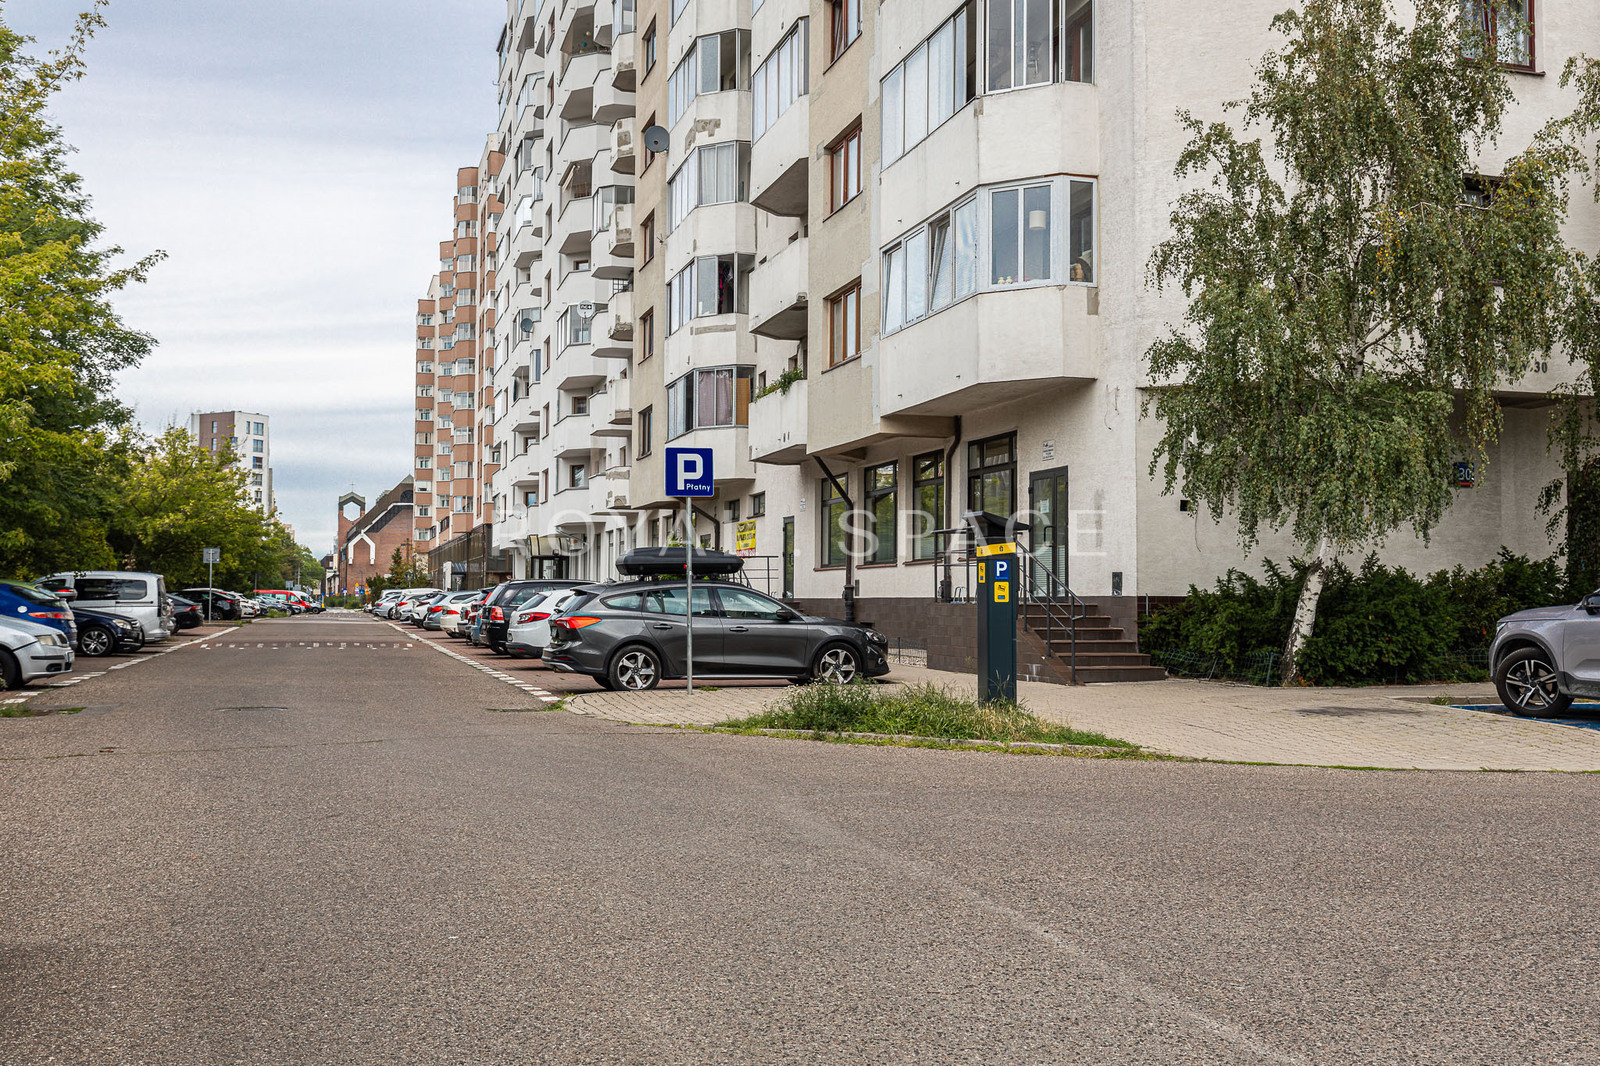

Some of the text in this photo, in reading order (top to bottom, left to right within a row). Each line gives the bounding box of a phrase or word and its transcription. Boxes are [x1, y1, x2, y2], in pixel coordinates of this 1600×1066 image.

[1534, 361, 1548, 373] 30
[677, 453, 703, 490] P
[1459, 467, 1471, 480] 30
[996, 561, 1008, 577] P
